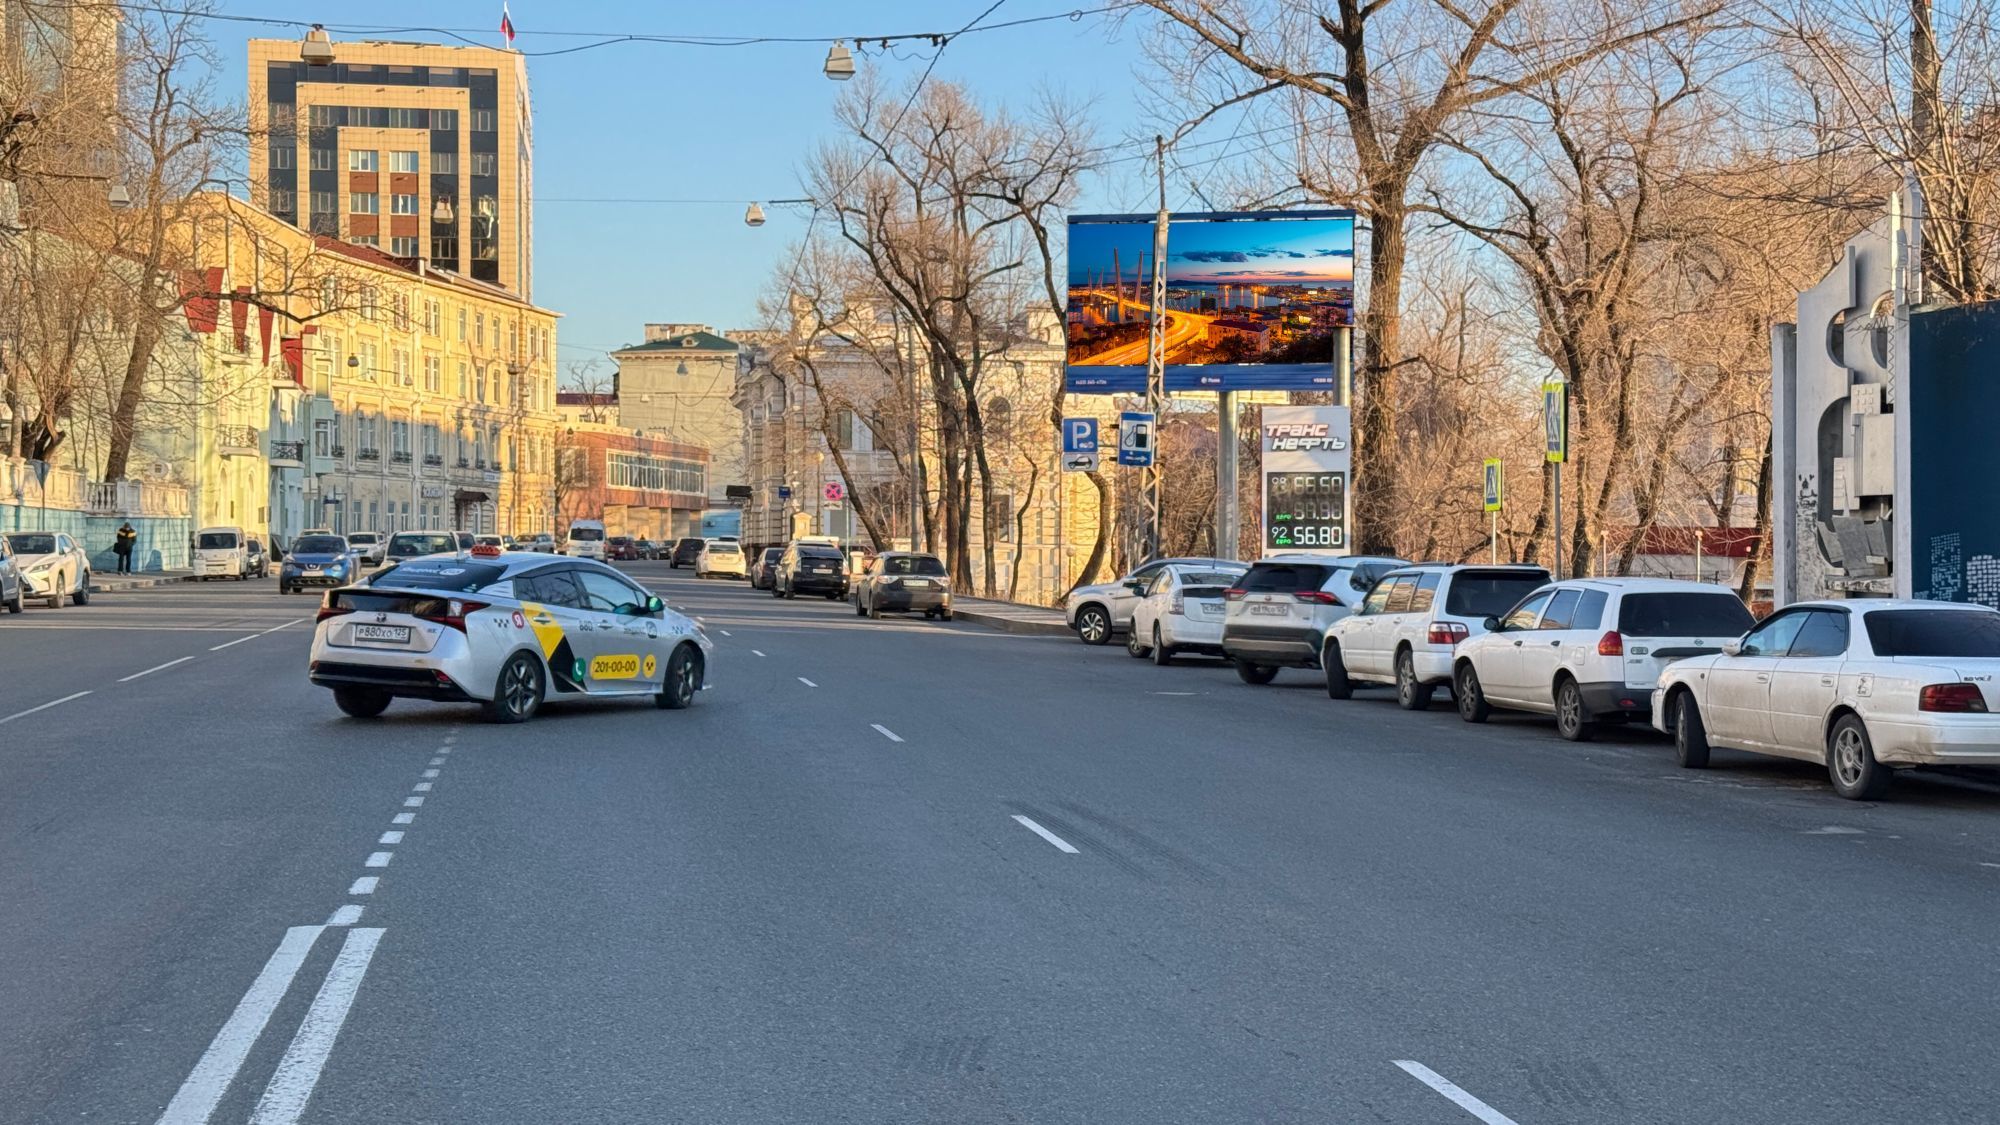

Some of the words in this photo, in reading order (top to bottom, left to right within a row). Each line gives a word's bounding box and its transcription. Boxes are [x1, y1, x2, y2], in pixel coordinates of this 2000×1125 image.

[1072, 421, 1092, 450] P
[1271, 526, 1287, 538] 92
[1294, 526, 1342, 545] 56.80
[594, 660, 636, 673] 201-00-00
